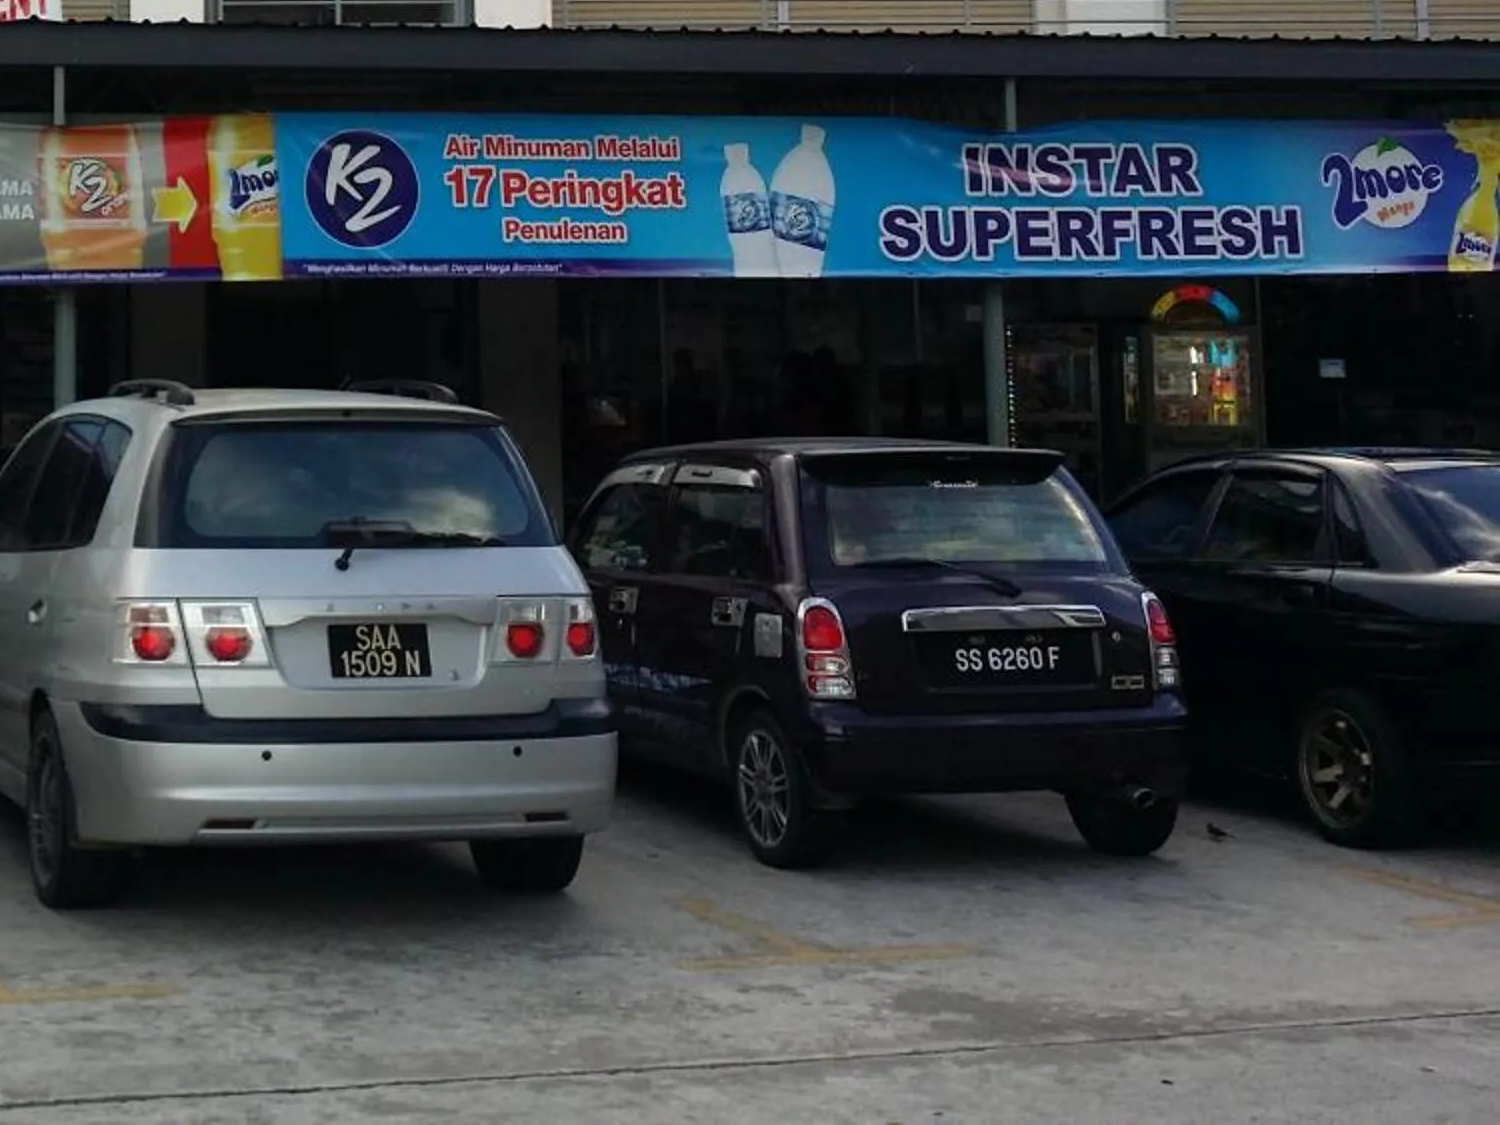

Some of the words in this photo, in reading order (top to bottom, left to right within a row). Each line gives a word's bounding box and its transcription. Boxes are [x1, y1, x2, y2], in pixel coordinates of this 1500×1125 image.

[444, 136, 481, 159] Air
[484, 136, 588, 159] Minuman
[594, 136, 679, 160] Melalui
[961, 142, 1203, 197] INSTAR
[325, 143, 400, 233] K2
[445, 167, 495, 208] 17
[501, 169, 685, 216] Peringkat
[503, 219, 627, 244] Penulenan
[880, 206, 1304, 261] SUPERFRESH
[355, 624, 401, 651] SAA
[340, 650, 398, 676] 1509
[405, 650, 421, 676] N
[955, 648, 983, 672] SS
[987, 647, 1044, 672] 6260
[1047, 646, 1060, 670] F
